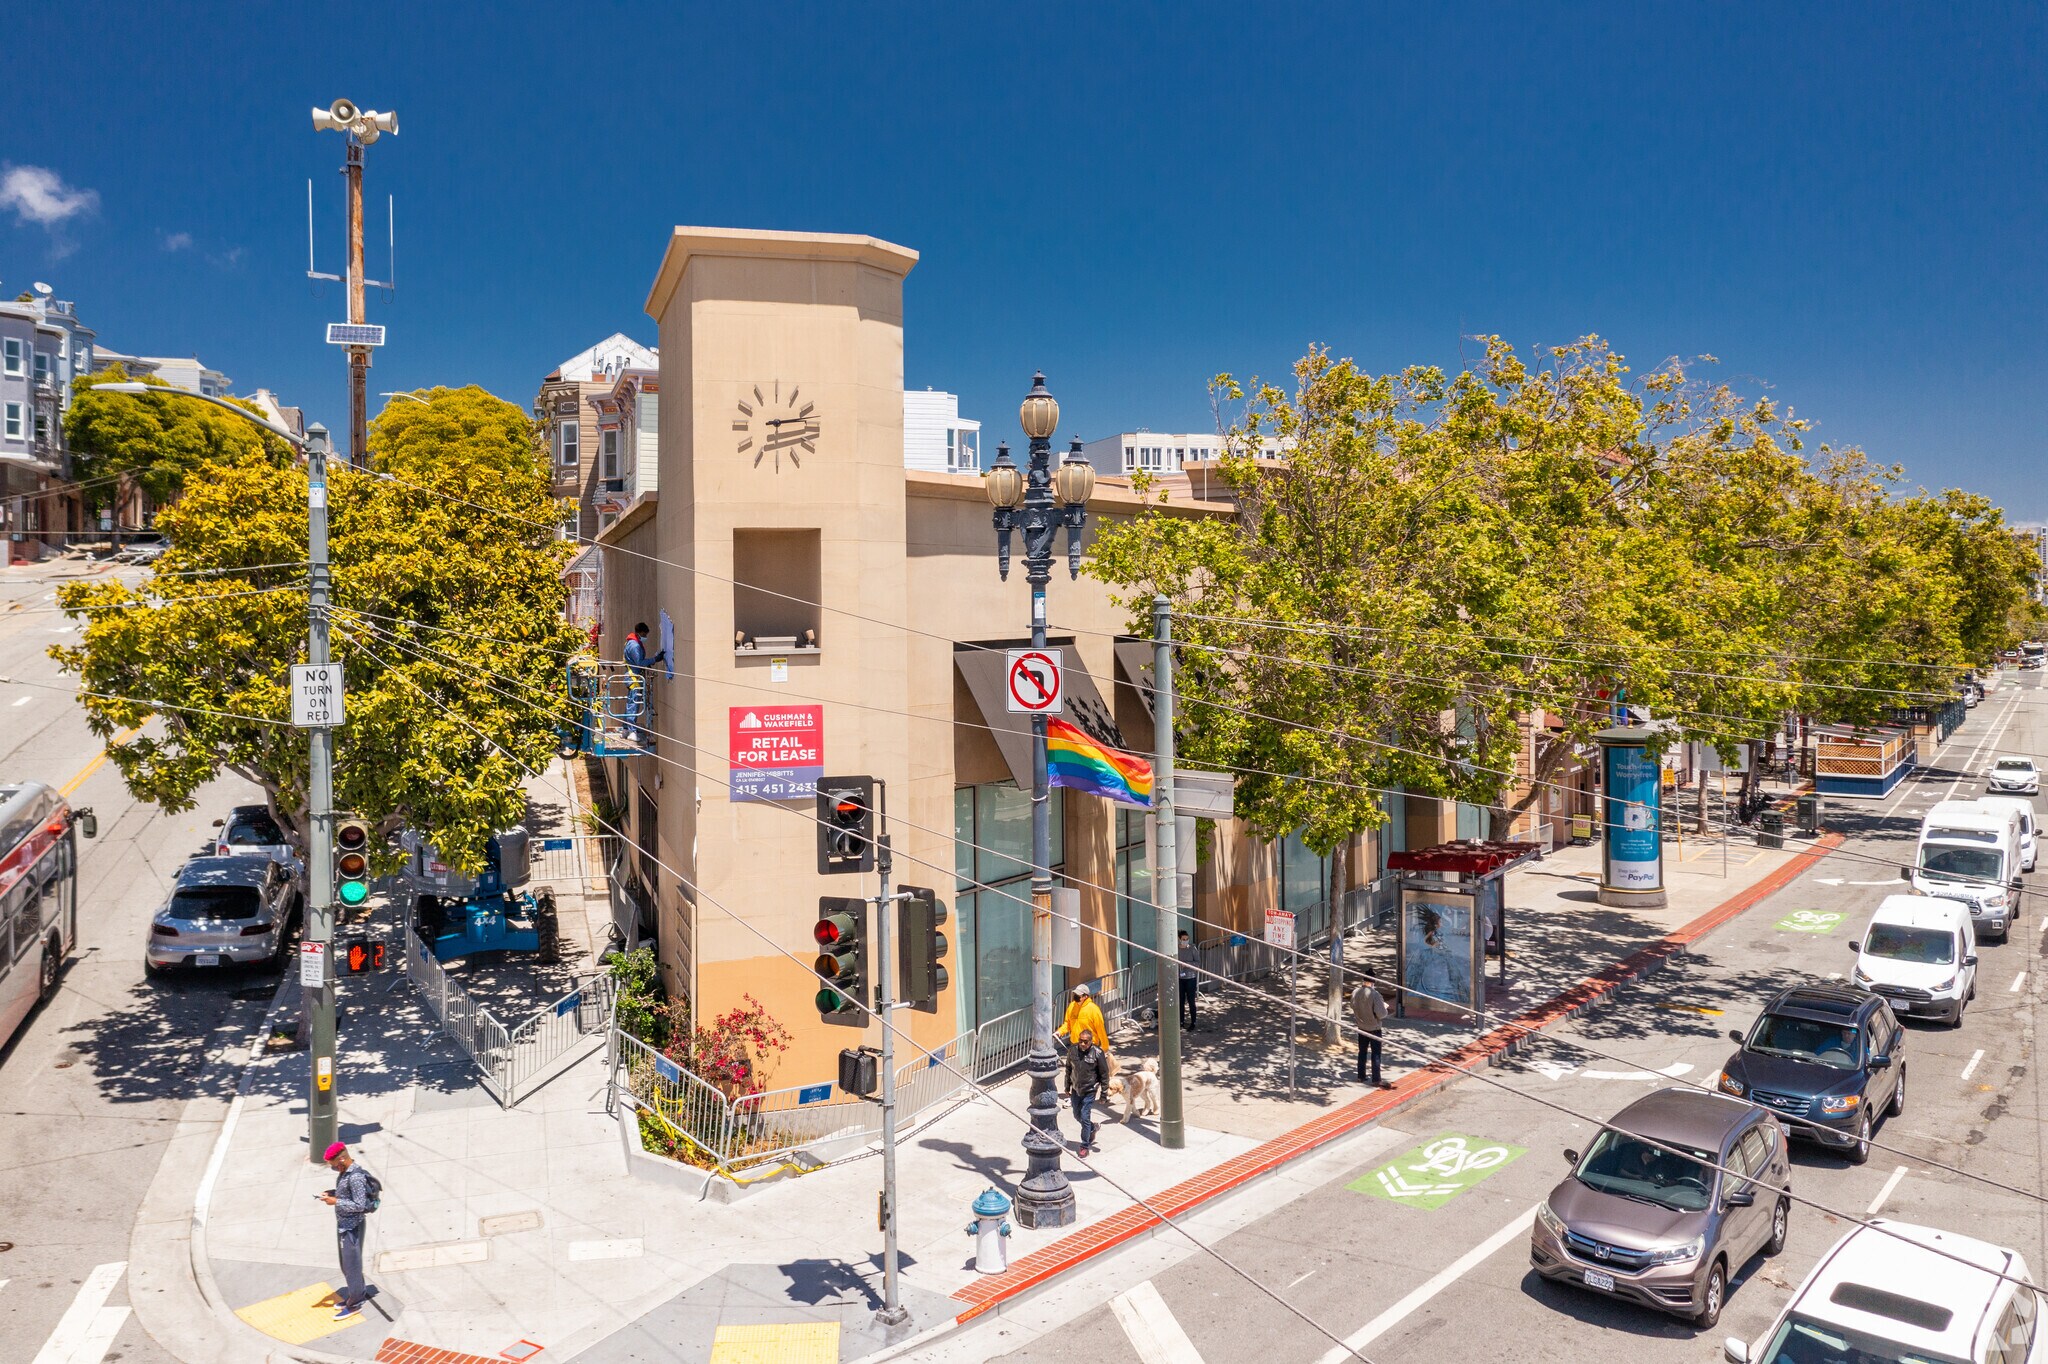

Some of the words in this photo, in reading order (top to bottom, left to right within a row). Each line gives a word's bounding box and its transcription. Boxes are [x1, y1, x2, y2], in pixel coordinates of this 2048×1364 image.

[305, 670, 328, 681] NO
[303, 685, 332, 695] TURN
[310, 699, 326, 707] ON
[307, 711, 329, 720] RED
[764, 720, 813, 728] WAKEFIELD
[752, 737, 802, 749] RETAIL
[738, 751, 768, 762] FOR
[772, 749, 816, 761] LEASE
[736, 784, 758, 794] 415
[763, 784, 784, 794] 451
[1628, 873, 1655, 881] PayPal
[1273, 925, 1285, 933] ANY
[1272, 932, 1285, 940] TIME
